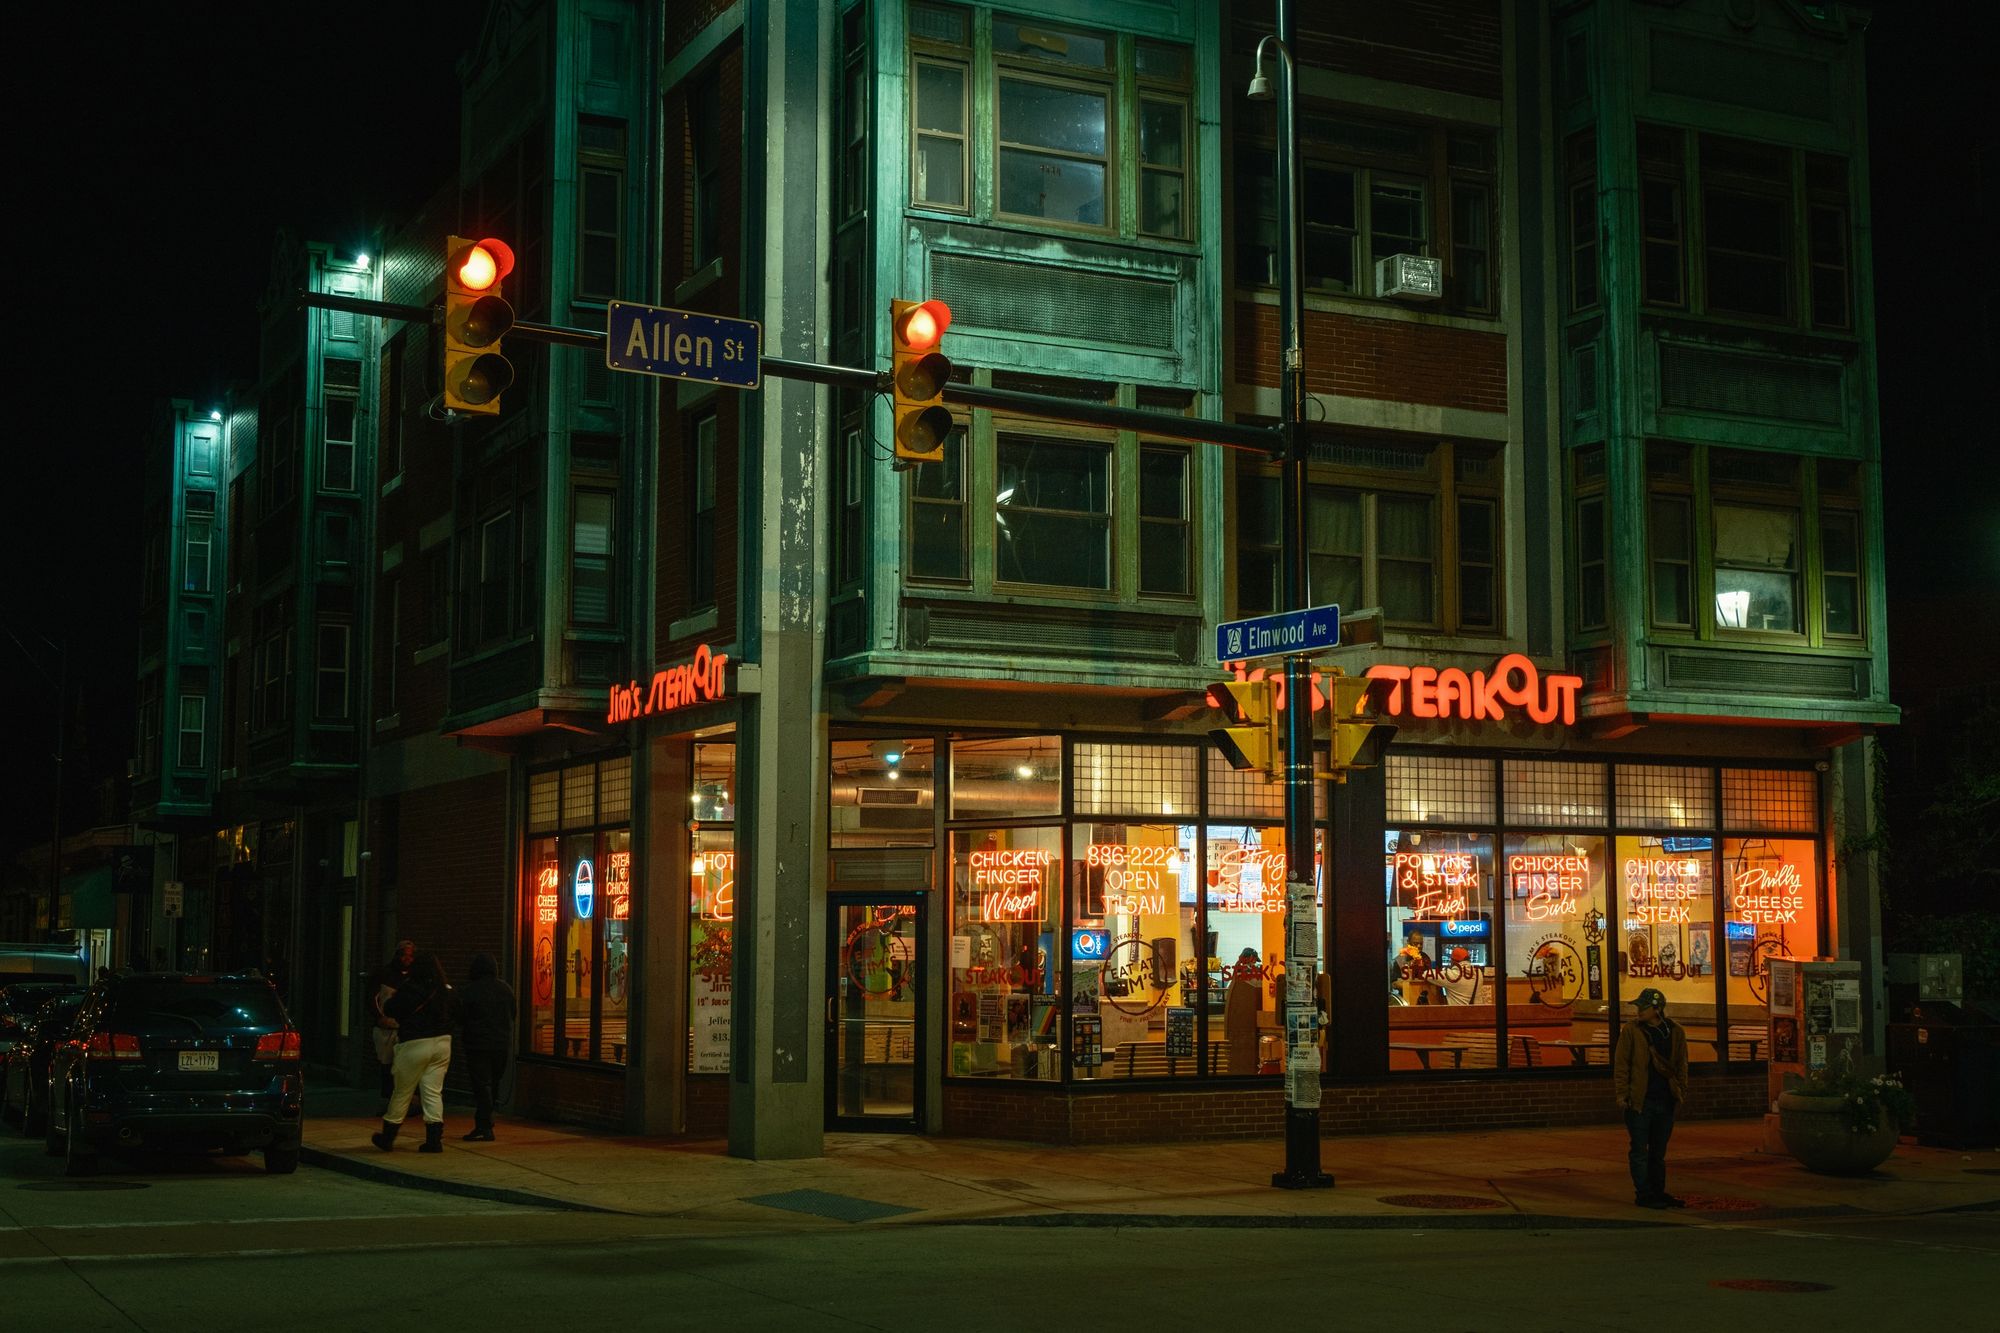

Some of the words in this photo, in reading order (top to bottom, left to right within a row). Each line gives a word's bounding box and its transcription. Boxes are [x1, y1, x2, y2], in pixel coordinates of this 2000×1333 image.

[625, 318, 713, 368] Allen
[723, 338, 745, 362] St
[1249, 620, 1304, 650] Elmwood
[1312, 622, 1327, 637] Ave
[607, 679, 642, 724] Jim's
[644, 643, 728, 715] STEAKOUT
[970, 851, 1049, 867] CHICKEN
[1088, 846, 1178, 866] 886-2222
[1397, 854, 1472, 869] POTINE
[1512, 857, 1589, 872] CHICKEN
[976, 869, 1041, 884] FINGER
[1109, 870, 1160, 890] OPEN
[1402, 870, 1418, 888] &
[1424, 873, 1478, 887] STEAK
[1517, 877, 1583, 890] FINGER
[1735, 864, 1802, 895] Philly
[1228, 882, 1281, 896] STEAK
[1630, 883, 1697, 899] CHEESE
[984, 887, 1037, 921] Wraps
[1126, 895, 1165, 915] 5AM
[1414, 890, 1466, 921] Fries
[1527, 892, 1577, 920] Subs
[1734, 896, 1804, 909] CHEESE
[1636, 906, 1691, 923] STEAK
[1742, 910, 1797, 923] STEAK
[1458, 923, 1483, 933] pepsi
[1111, 963, 1134, 980] EAT
[1536, 962, 1555, 974] EAT
[1560, 955, 1573, 968] AT
[1630, 960, 1703, 981] STEAKOUT
[1541, 968, 1576, 993] JIM'S
